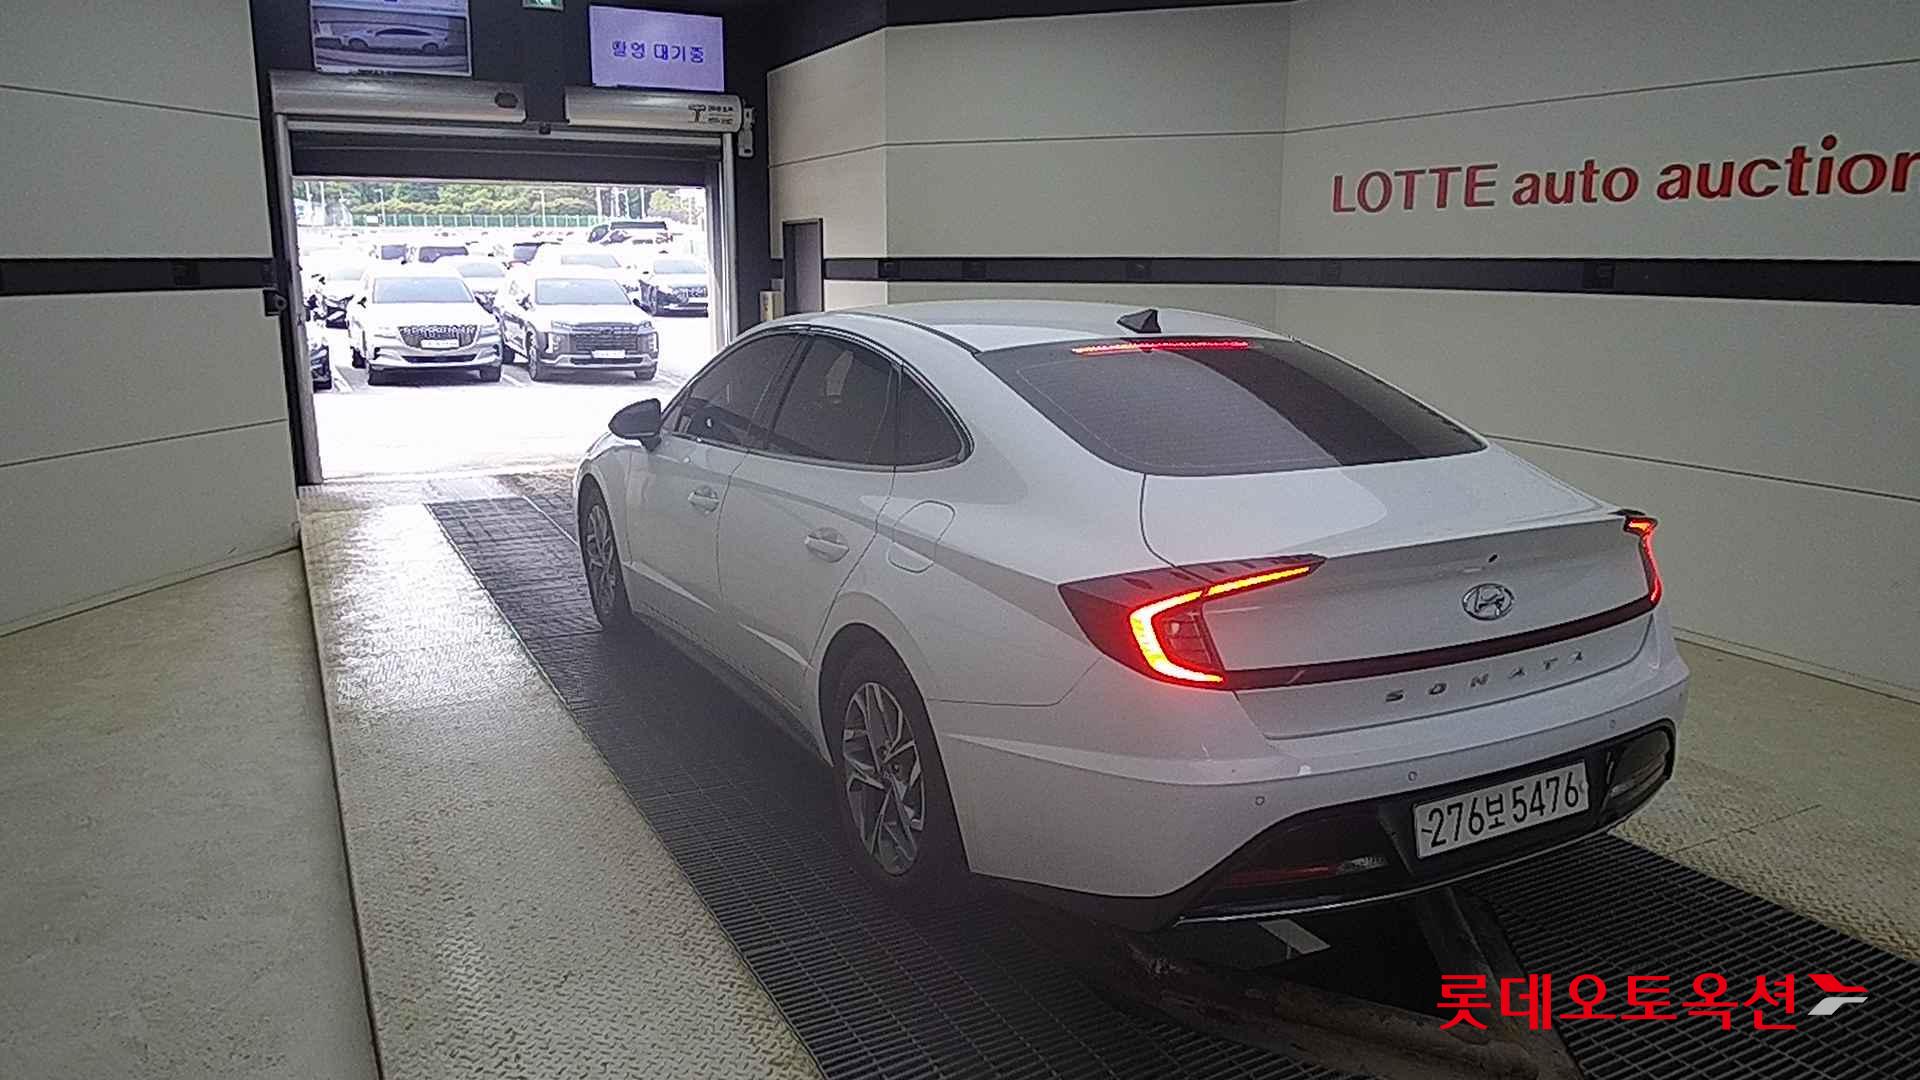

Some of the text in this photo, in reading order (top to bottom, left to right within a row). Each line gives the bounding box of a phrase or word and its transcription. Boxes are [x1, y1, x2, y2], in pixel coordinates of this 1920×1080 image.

[612, 40, 704, 64] 촬영 대기중
[1332, 163, 1498, 213] LOTTE
[1511, 158, 1640, 206] auto
[1385, 651, 1583, 703] SONATA
